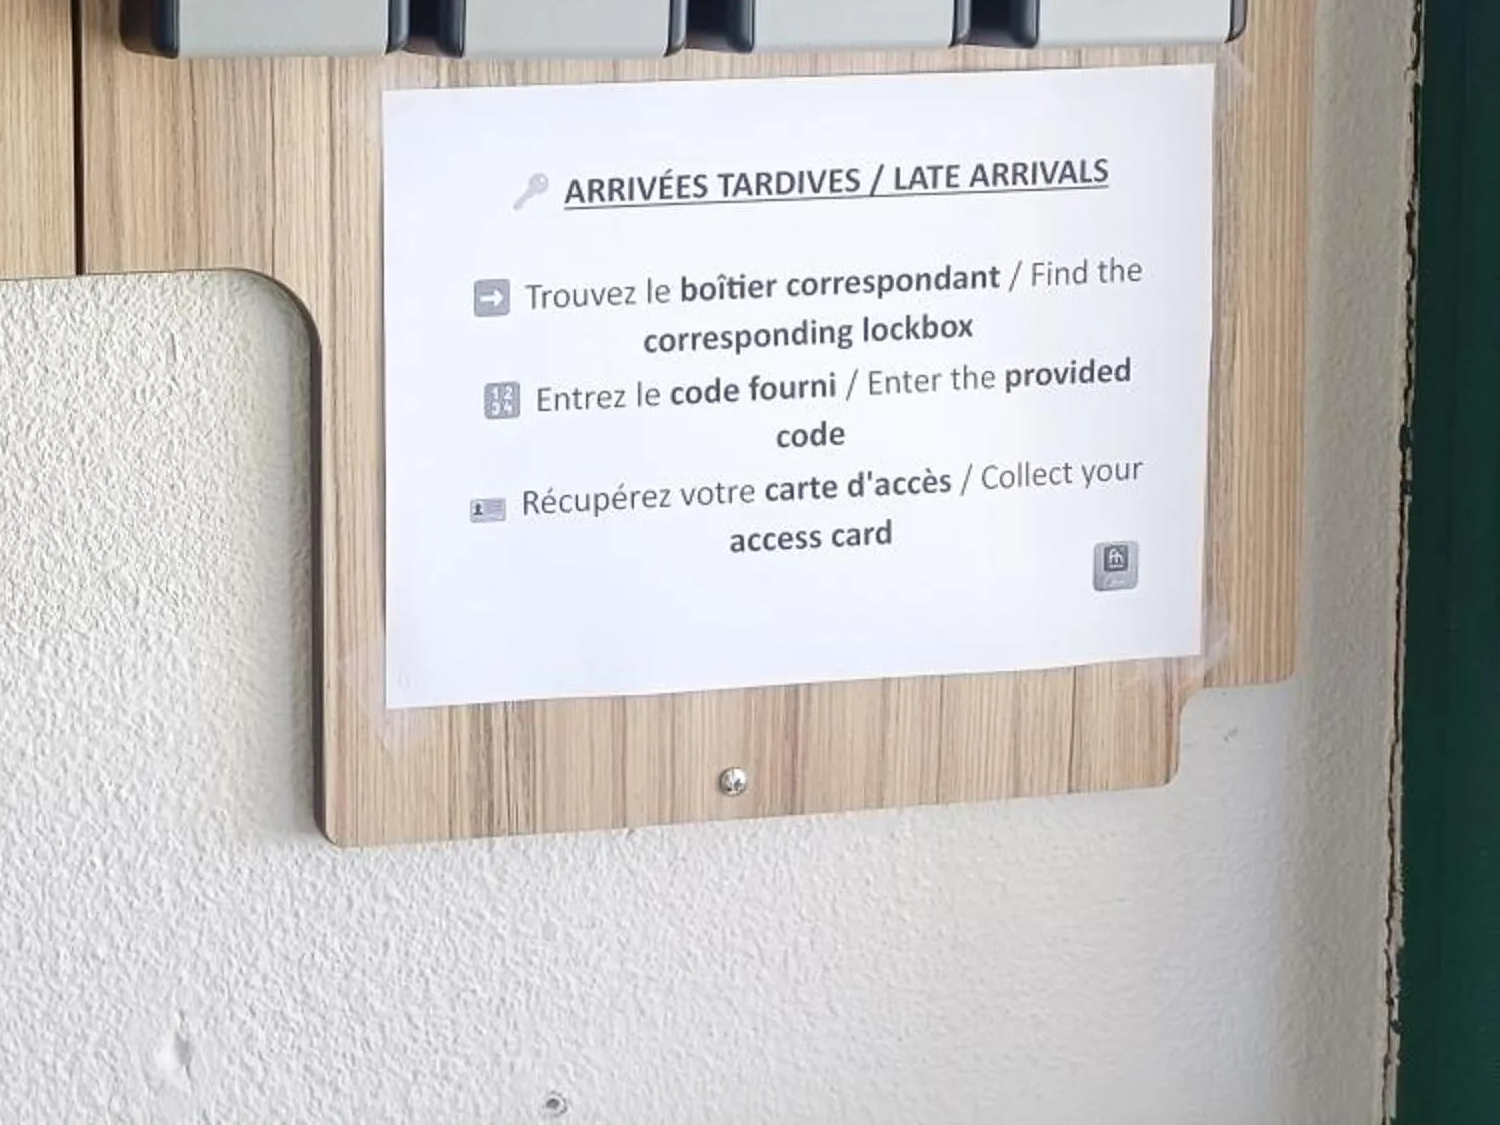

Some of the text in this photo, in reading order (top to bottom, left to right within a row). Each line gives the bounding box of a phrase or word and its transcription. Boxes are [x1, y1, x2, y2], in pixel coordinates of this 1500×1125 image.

[565, 159, 1109, 204] ARRIVÉES TARDIVES / LATE ARRIVALS
[525, 257, 1142, 309] Trouvez le boîtier correspondant / Find the
[644, 314, 972, 355] corresponding lockbox
[538, 357, 1130, 411] Entrez le code fourni / Enter the provided
[777, 421, 845, 448] code
[524, 461, 1143, 517] Récupérez votre carte d'accès / Collect your
[730, 519, 892, 553] access card
